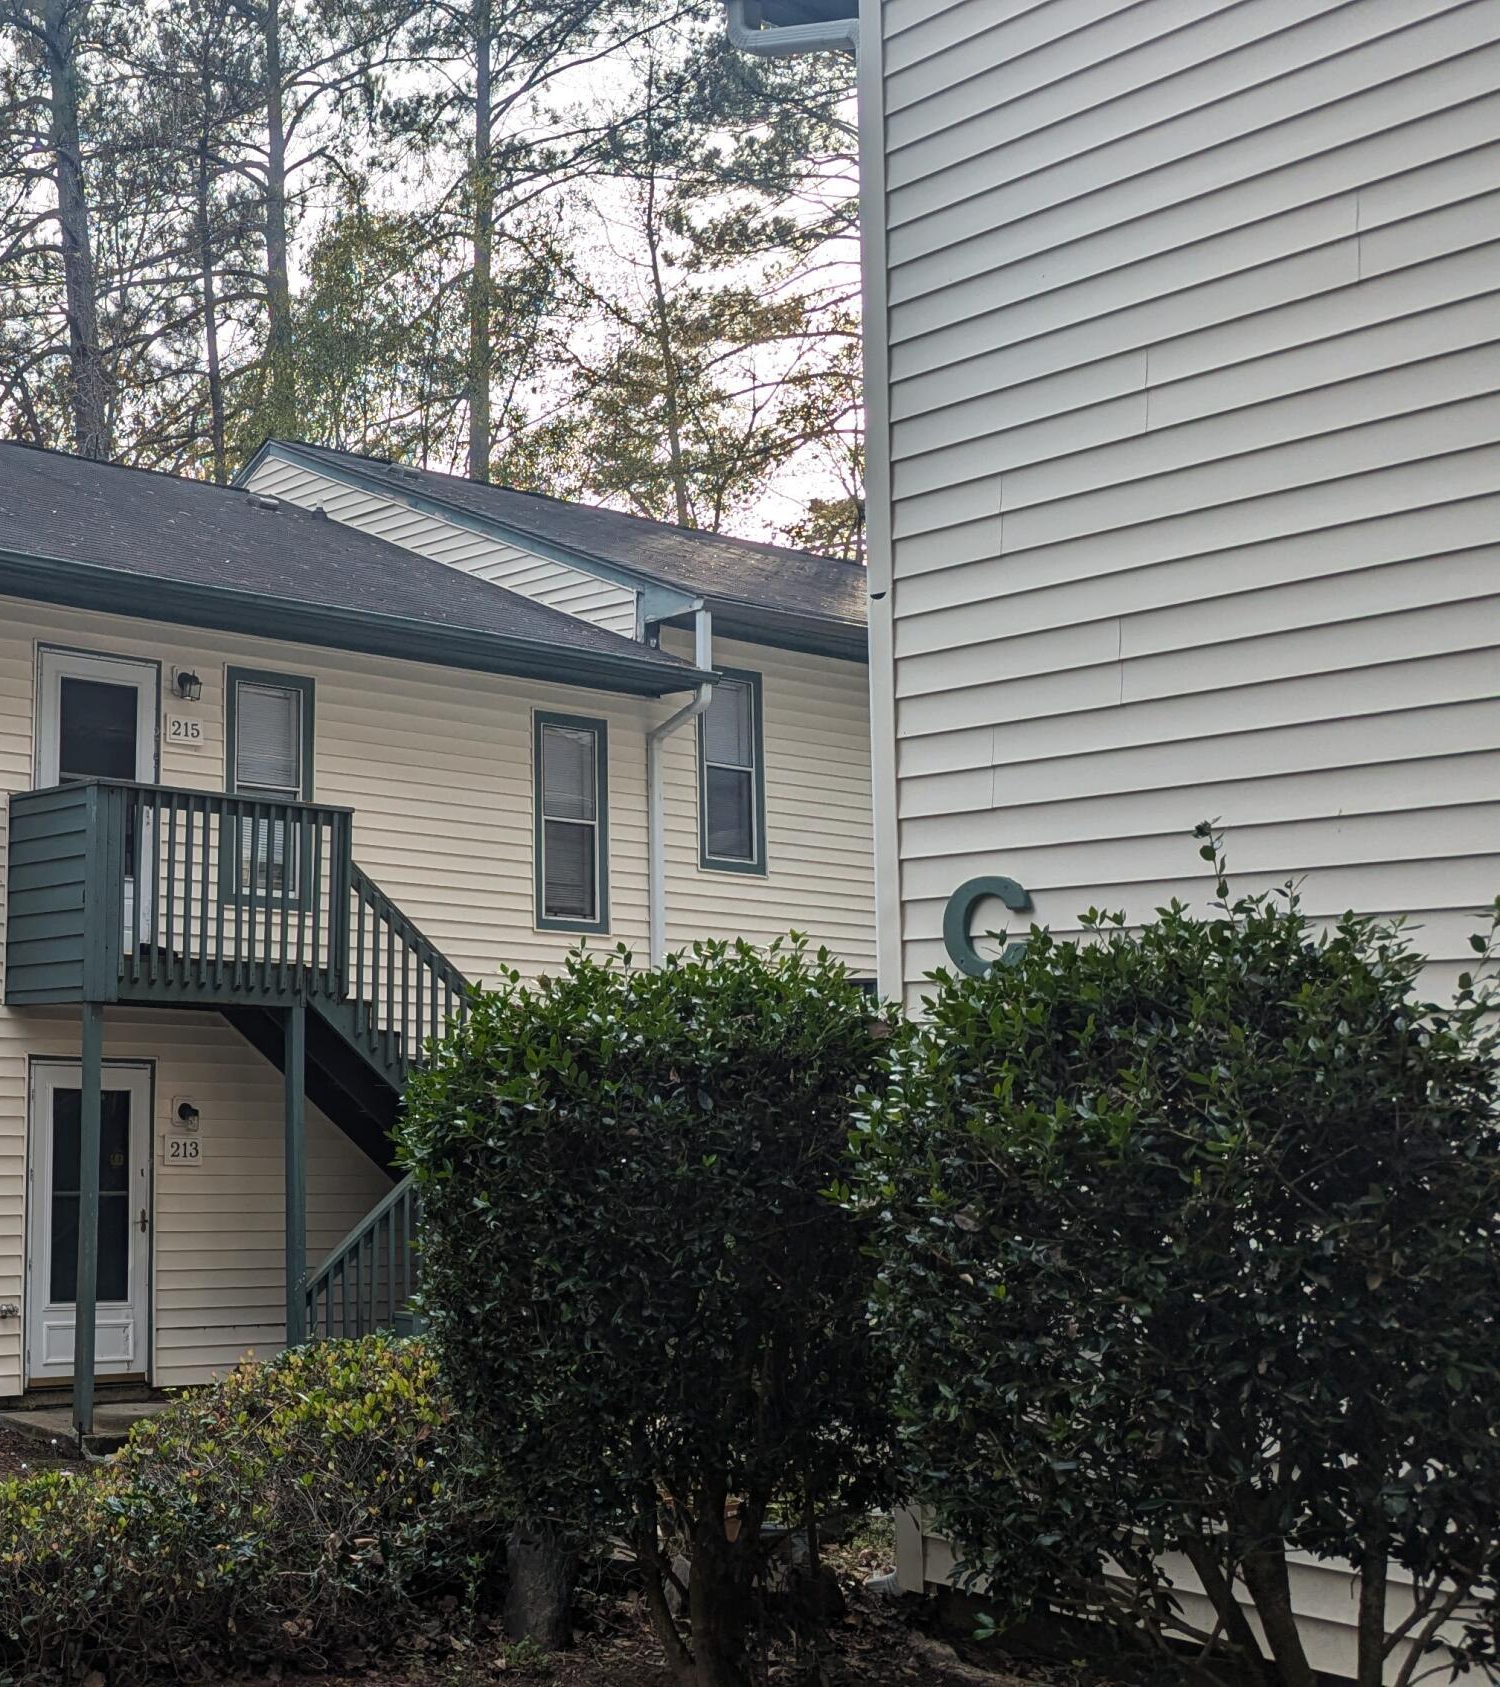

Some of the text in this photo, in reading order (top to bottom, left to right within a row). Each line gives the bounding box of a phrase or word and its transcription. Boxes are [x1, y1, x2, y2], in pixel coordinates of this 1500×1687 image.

[171, 720, 200, 738] 215
[943, 875, 1031, 979] C
[170, 1141, 200, 1158] 213
